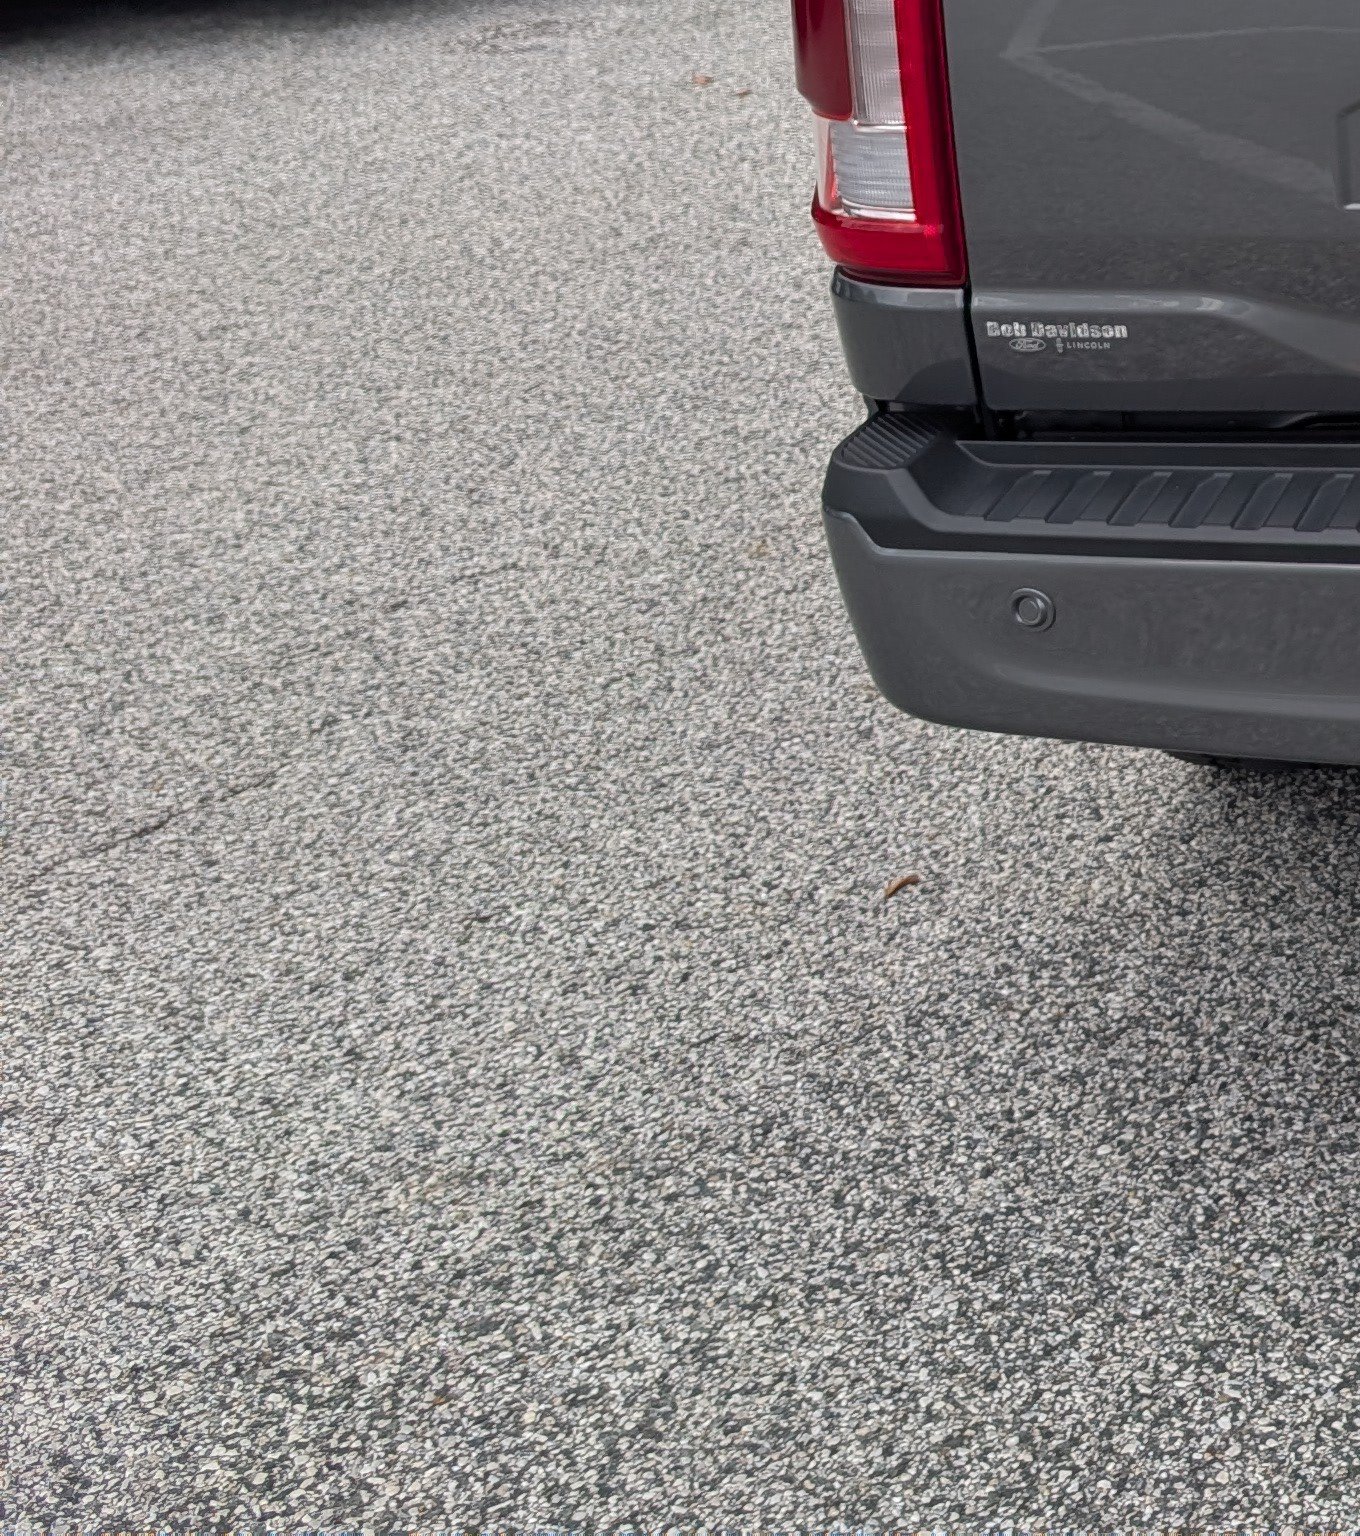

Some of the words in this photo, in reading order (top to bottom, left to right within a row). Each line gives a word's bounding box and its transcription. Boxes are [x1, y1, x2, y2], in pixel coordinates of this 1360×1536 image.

[986, 321, 1027, 337] Bob
[1030, 322, 1128, 338] Davidson
[1066, 341, 1111, 350] LINCOLN
